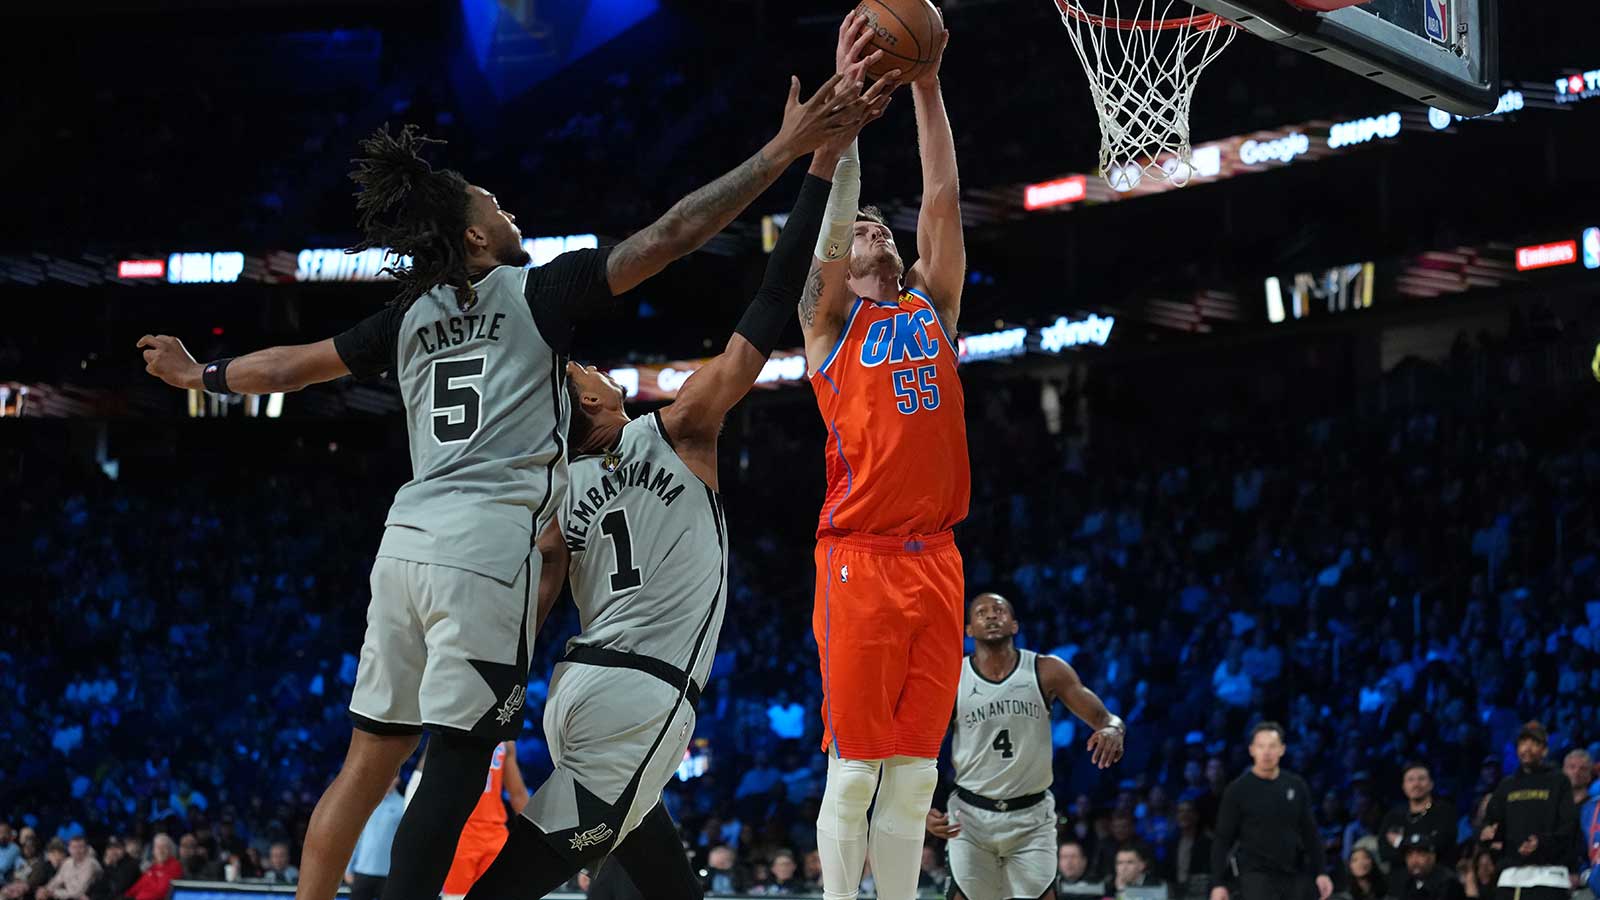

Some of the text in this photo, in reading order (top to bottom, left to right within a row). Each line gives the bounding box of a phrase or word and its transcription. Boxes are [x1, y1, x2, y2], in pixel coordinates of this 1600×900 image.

[1239, 131, 1309, 165] Google
[416, 312, 506, 354] CASTLE
[860, 307, 940, 368] OKC
[1041, 313, 1114, 353] xfinity
[430, 354, 487, 446] 5
[892, 364, 941, 415] 55
[565, 461, 686, 551] WEMBANYAMA
[600, 506, 643, 595] 1
[965, 700, 1041, 729] SAN ANTONIO
[991, 728, 1014, 760] 4
